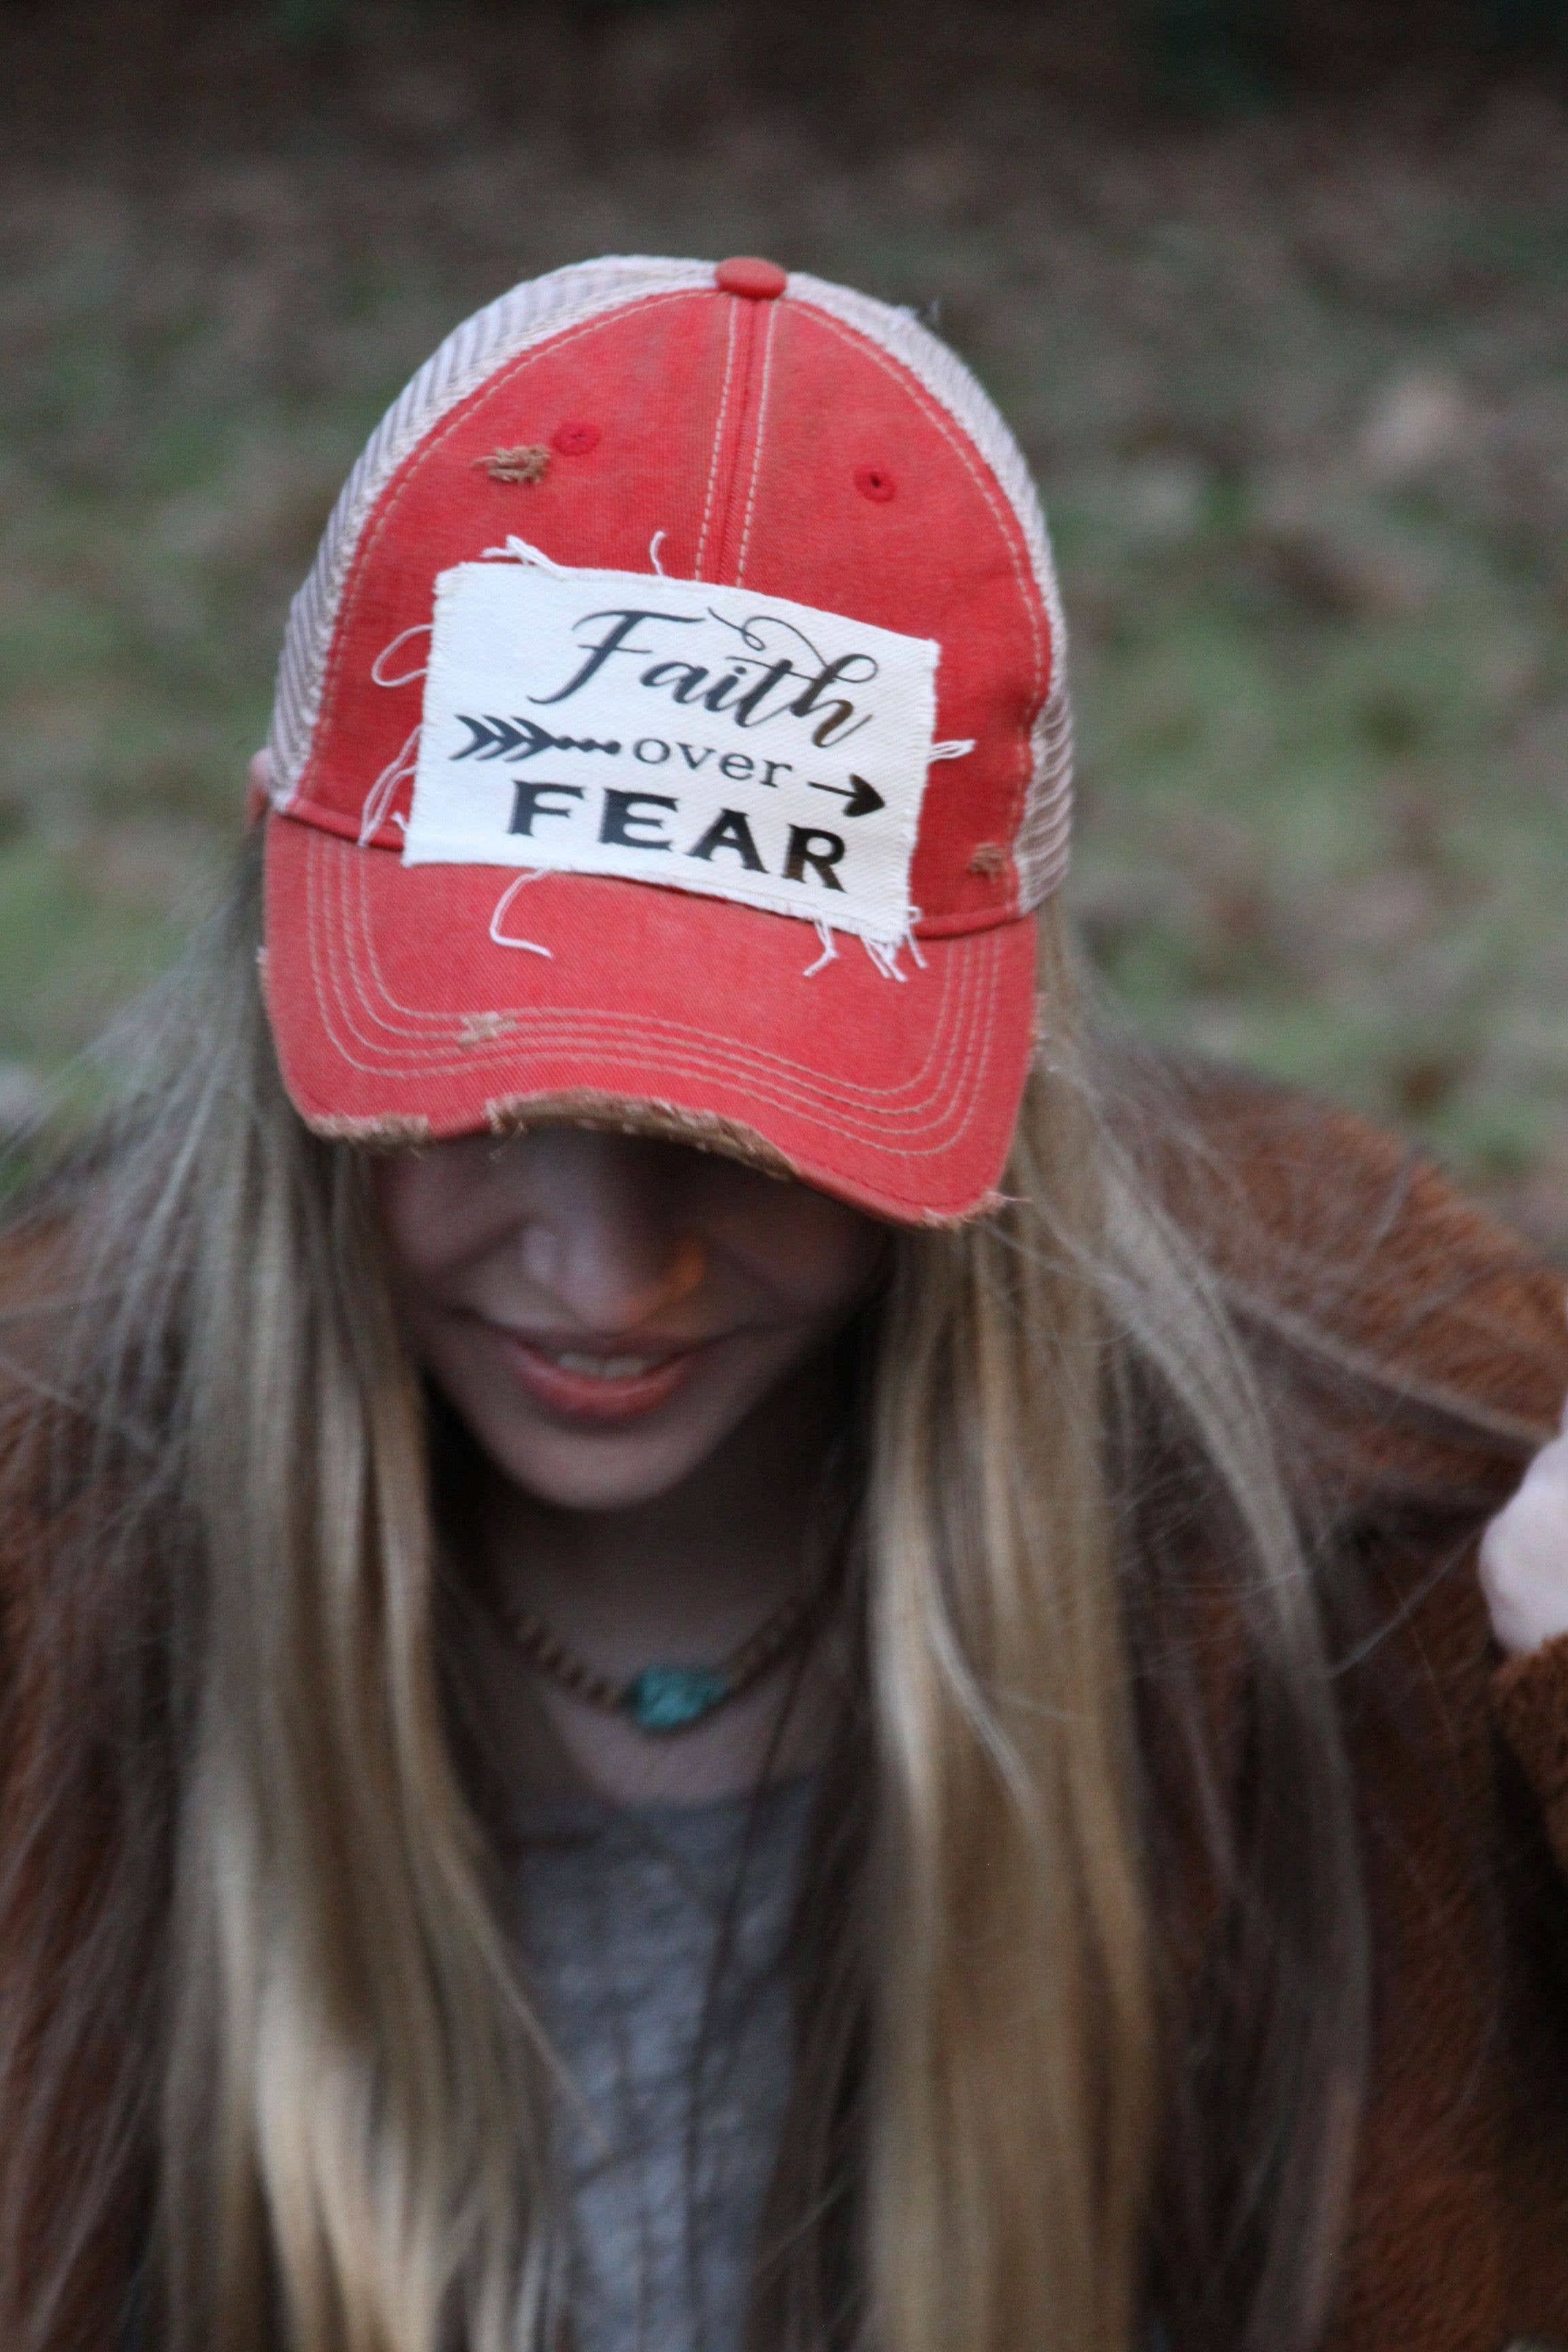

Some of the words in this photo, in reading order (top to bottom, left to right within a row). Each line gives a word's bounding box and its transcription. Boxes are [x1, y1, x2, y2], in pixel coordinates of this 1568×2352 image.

[527, 607, 879, 748] Faith
[634, 736, 793, 787] over
[506, 780, 847, 893] FEAR
